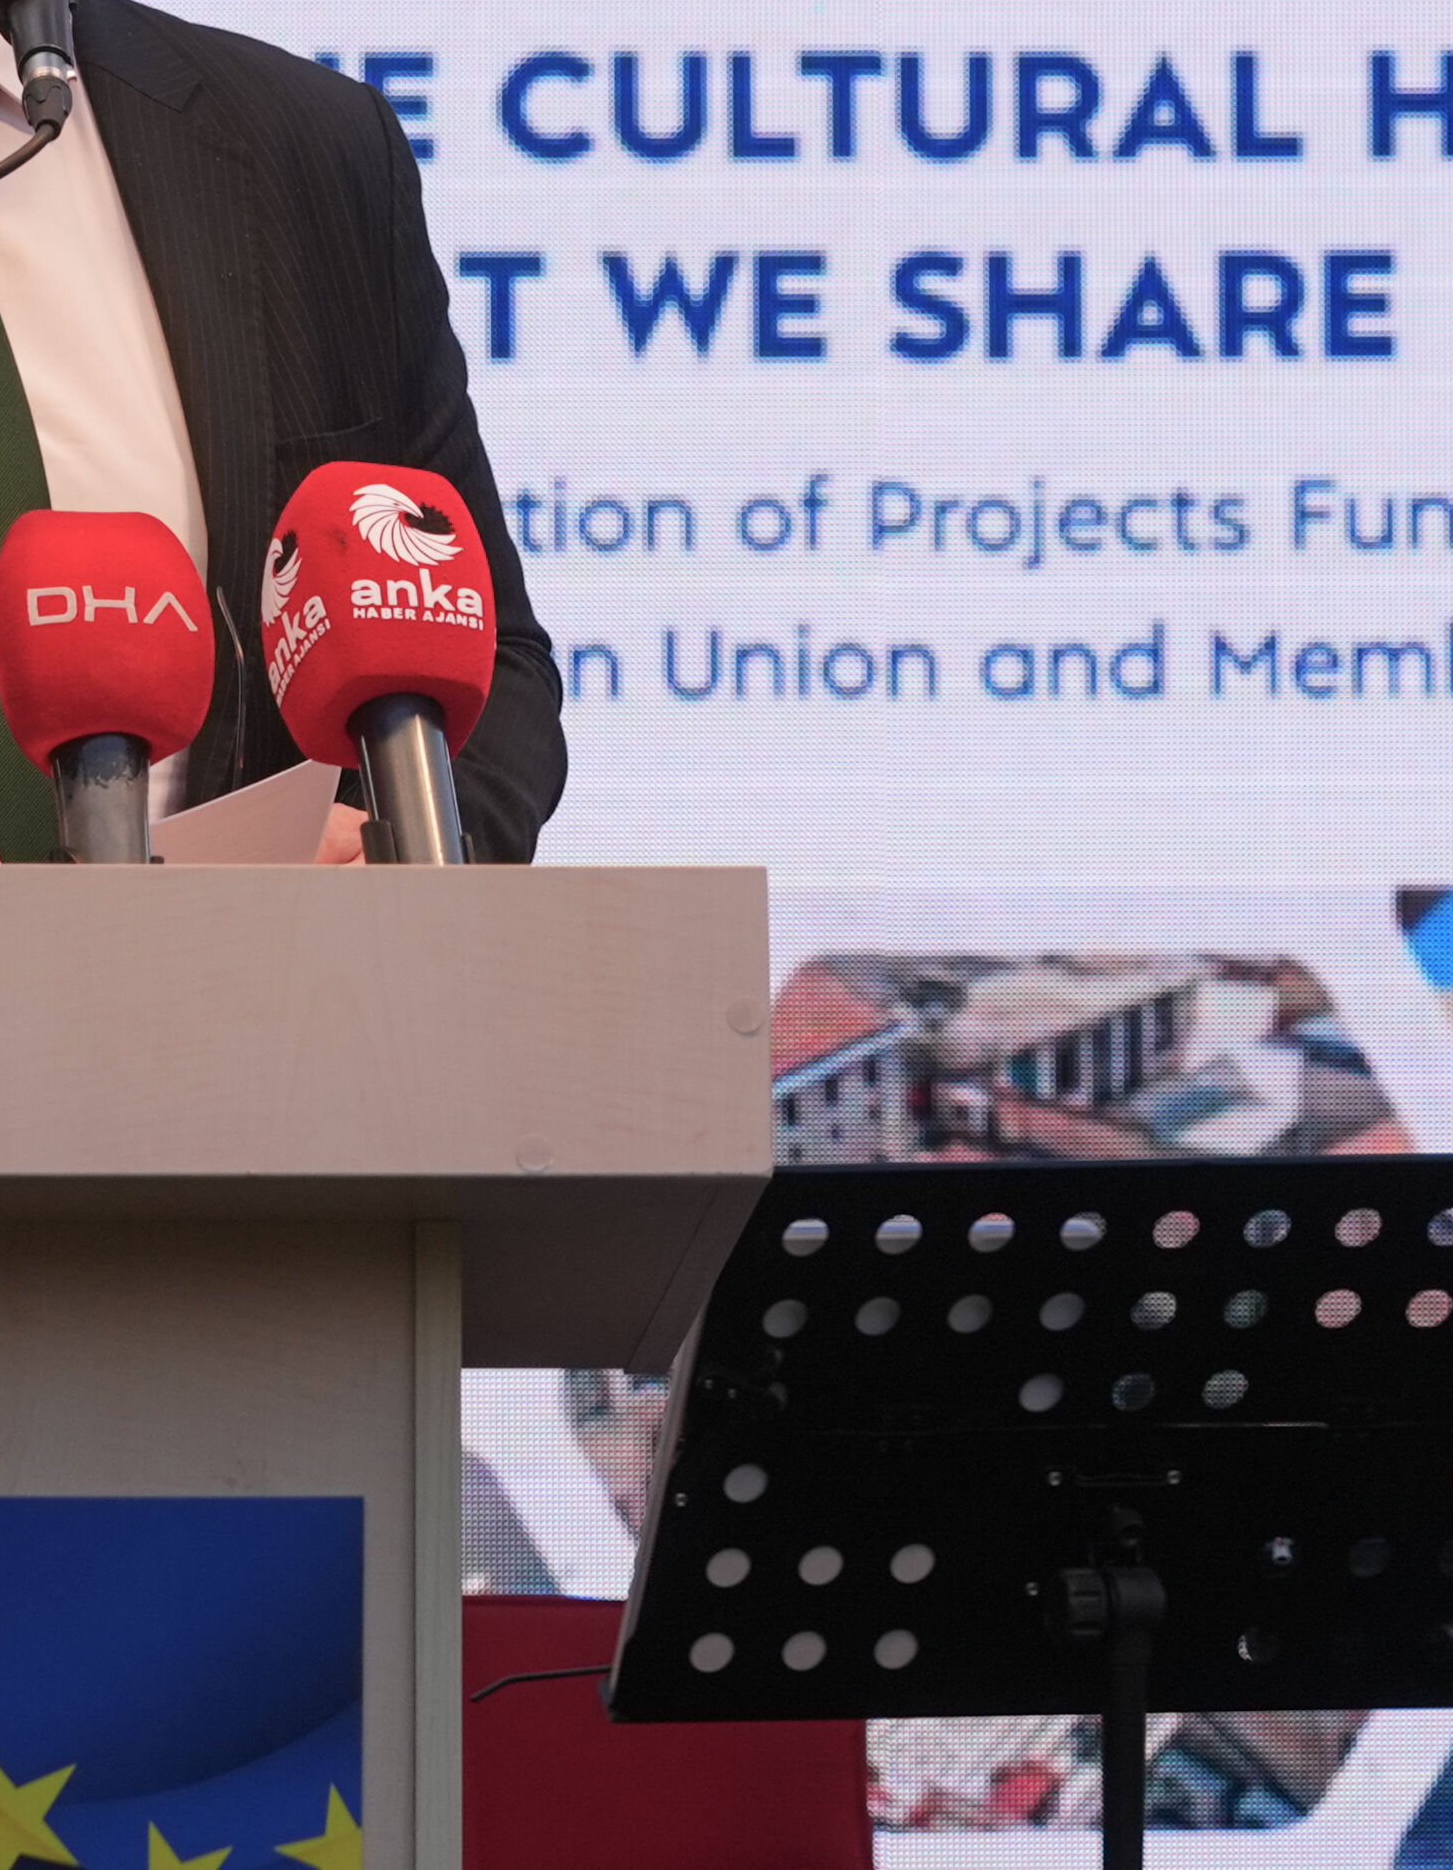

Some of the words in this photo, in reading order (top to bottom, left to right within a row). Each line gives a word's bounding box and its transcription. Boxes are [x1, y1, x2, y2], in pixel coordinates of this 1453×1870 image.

[496, 49, 1305, 164] CULTURAL
[600, 249, 829, 362] WE
[887, 247, 1399, 364] SHARE
[735, 473, 829, 555] of
[869, 475, 1251, 572] Projects
[350, 568, 483, 615] anka
[352, 606, 417, 620] HABER
[422, 613, 484, 631] AJANSI
[267, 594, 328, 696] anka
[662, 626, 938, 703] Union
[981, 621, 1166, 703] and
